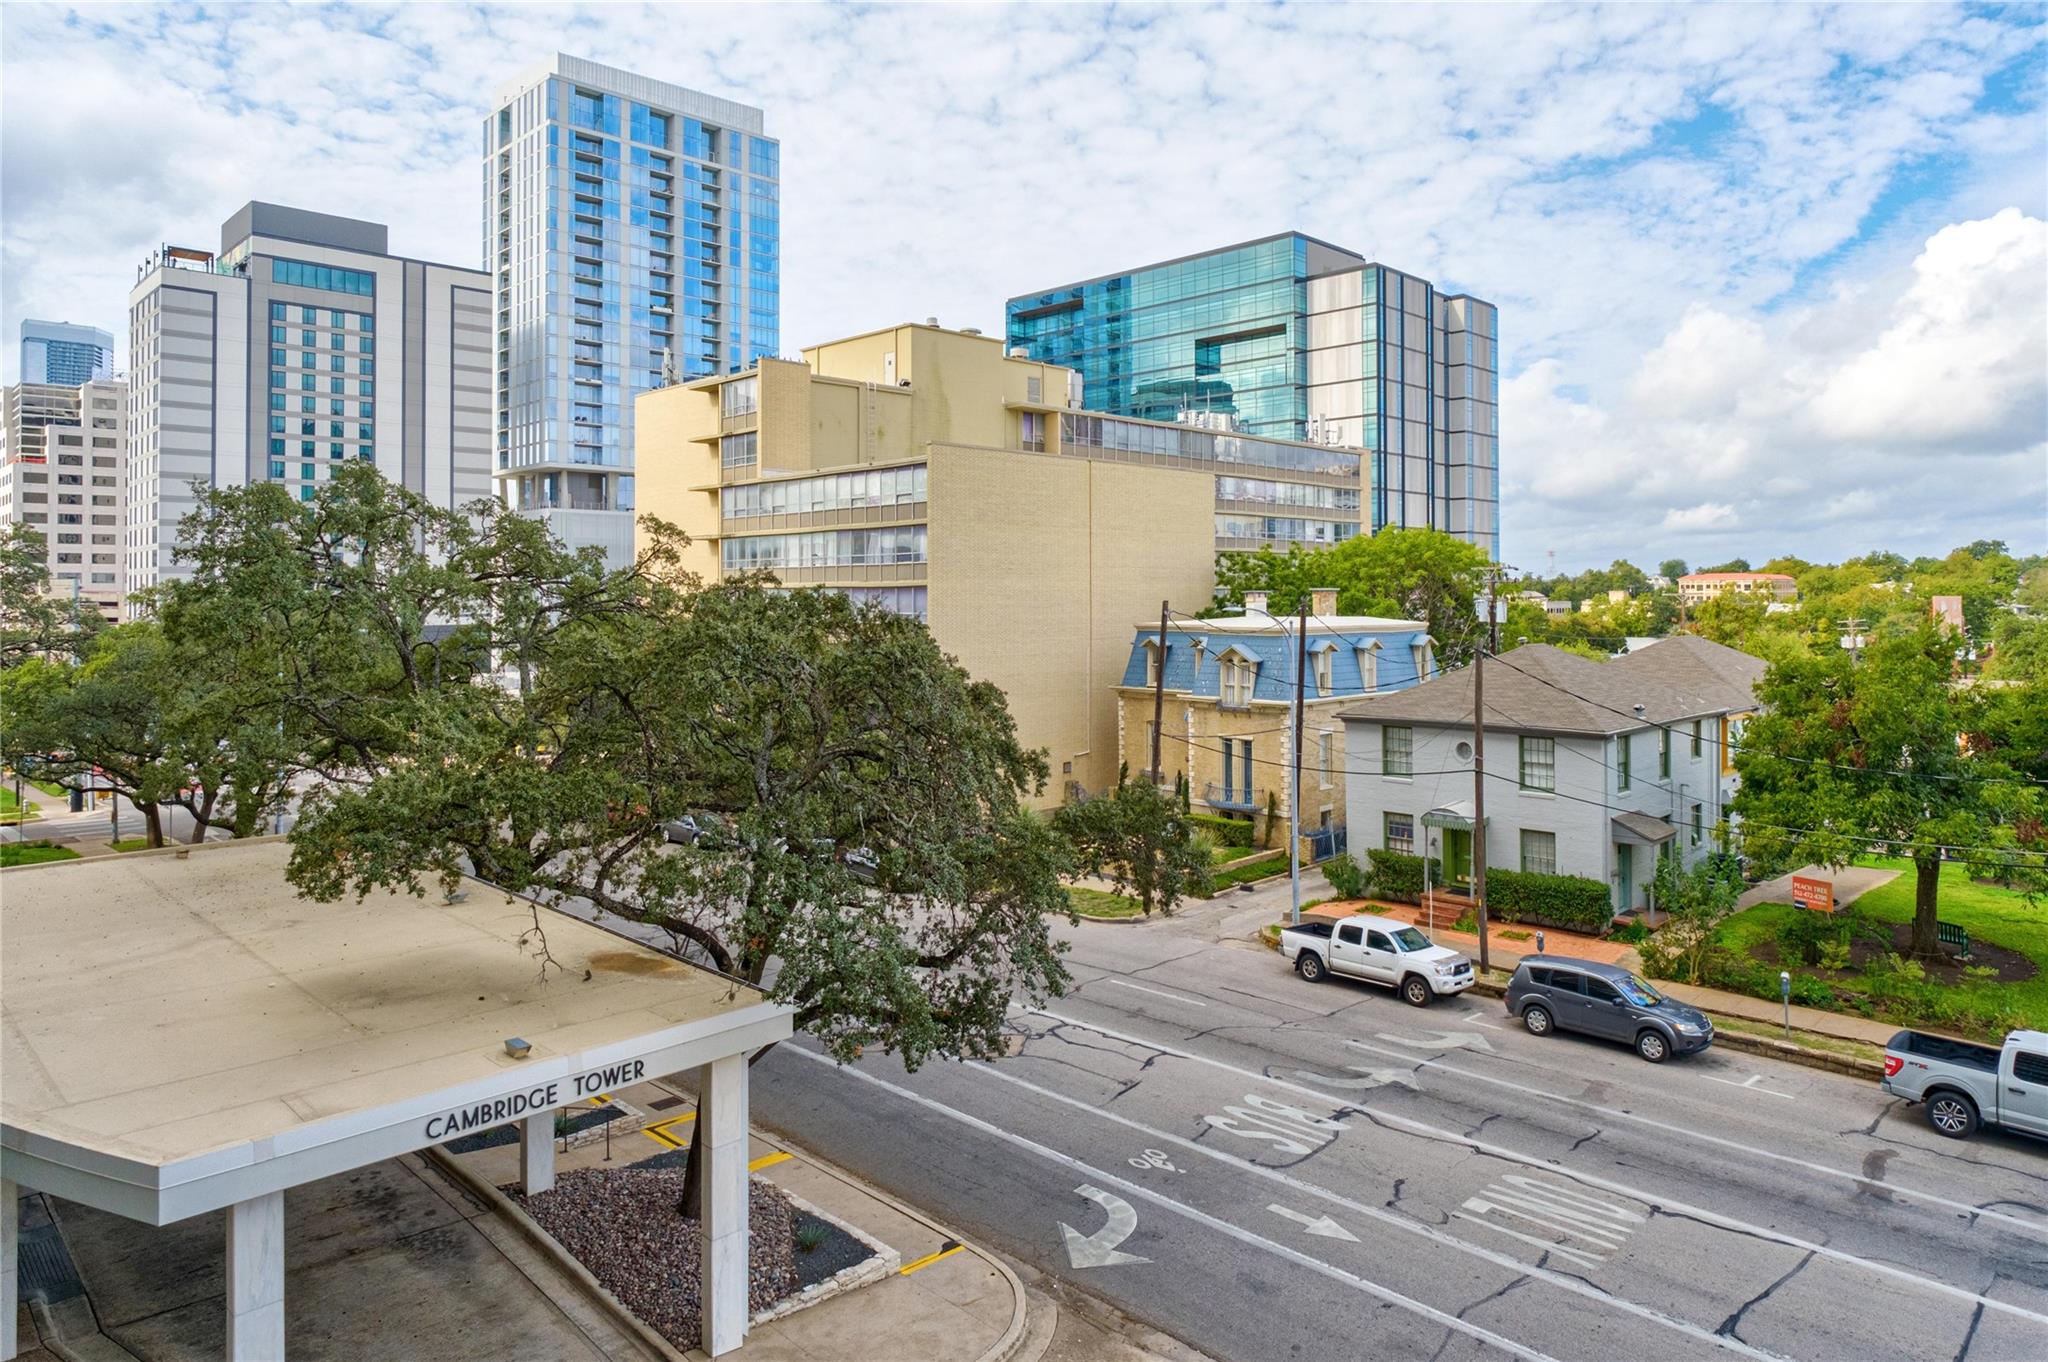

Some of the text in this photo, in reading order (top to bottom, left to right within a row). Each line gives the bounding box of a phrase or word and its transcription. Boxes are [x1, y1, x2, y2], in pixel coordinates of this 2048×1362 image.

[1793, 882, 1828, 895] PEACH TREE
[425, 1060, 645, 1140] CAMBRIDGE TOWER
[1203, 1093, 1351, 1154] BUS
[1451, 1174, 1646, 1270] ONLY
